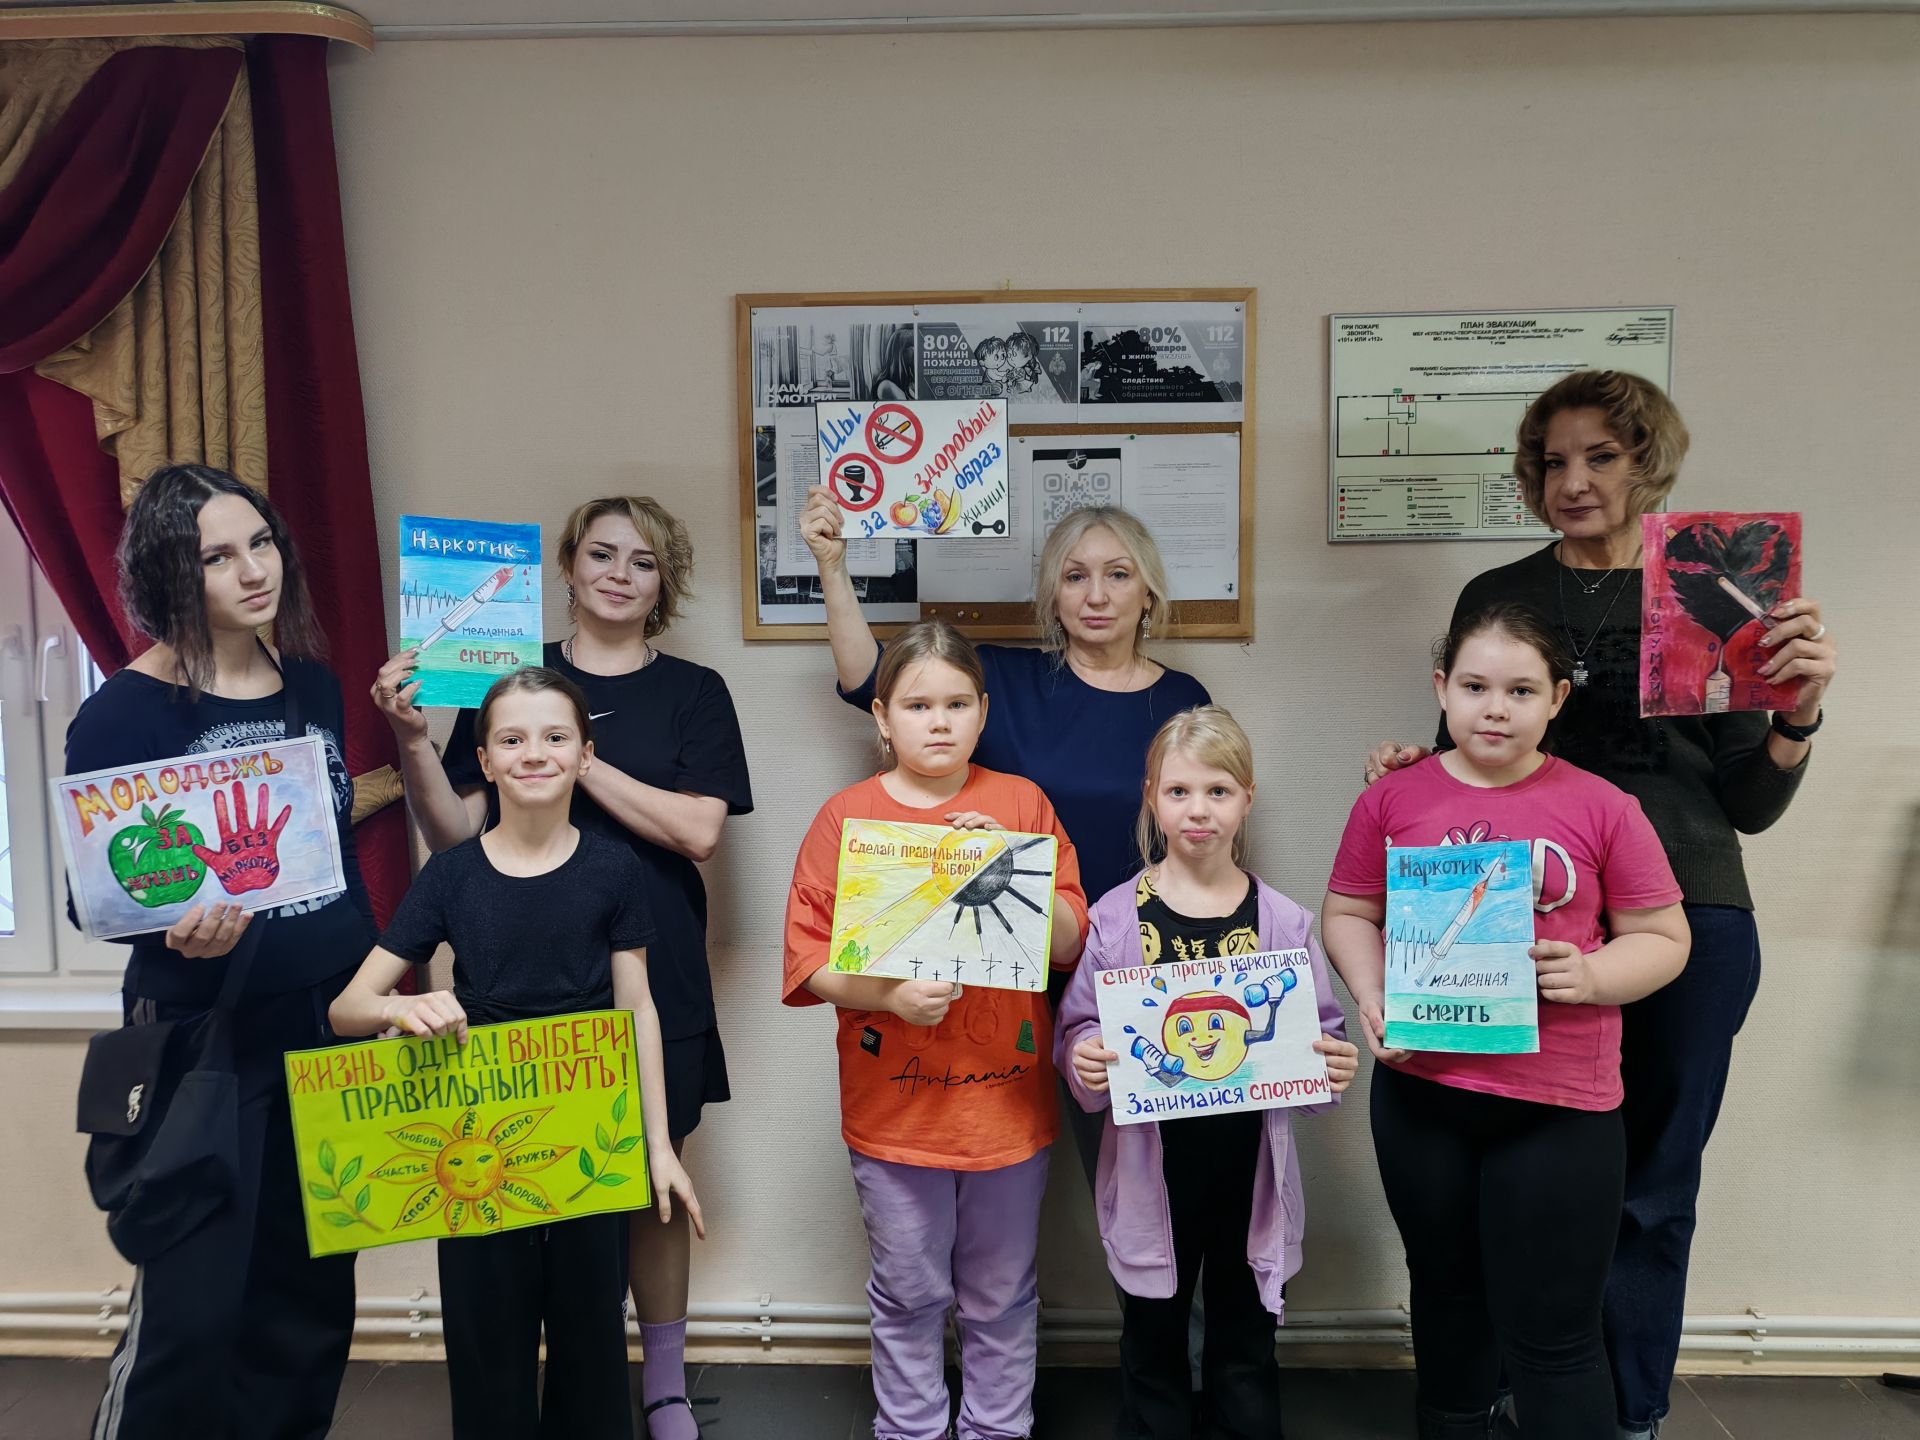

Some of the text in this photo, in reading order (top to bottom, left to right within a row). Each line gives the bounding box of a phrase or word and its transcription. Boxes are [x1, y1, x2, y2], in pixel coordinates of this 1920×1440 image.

[1486, 320, 1536, 328] ЭВАКУАЦИИ
[923, 334, 968, 350] 80%
[1043, 327, 1070, 342] 112
[1139, 327, 1182, 343] 80%
[1207, 326, 1234, 342] 112
[923, 351, 968, 359] ПРИЧИН
[1145, 345, 1187, 353] пожаров
[923, 359, 978, 367] ПОЖАРОВ
[935, 385, 944, 396] С
[860, 400, 1007, 539] за здоровый образ жизни!
[462, 626, 523, 638] медленная
[459, 649, 520, 664] СМЕРТЬ
[157, 824, 192, 849] ЗА
[226, 832, 267, 854] БЕЗ
[848, 838, 895, 856] Сделай
[127, 864, 199, 890] ЖИЗНЬ
[290, 1017, 631, 1094] ЖИЗНЬ ОДНА! ВЫБЕРИ
[340, 1052, 628, 1122] ПРАВИЛЬНЫЙ ПУТЬ!
[1126, 1086, 1244, 1114] Занимайся
[462, 1111, 477, 1138] ТРУД
[494, 1114, 533, 1146] ДОБРО
[398, 1131, 444, 1148] ЛЮБОВЬ
[504, 1149, 558, 1168] ДРУЖБА
[376, 1164, 429, 1177] СЧАСТЬЕ
[500, 1180, 551, 1212] ЗДОРОВЬЕ
[403, 1188, 440, 1223] СПОРТ
[477, 1200, 500, 1225] ЗОЖ
